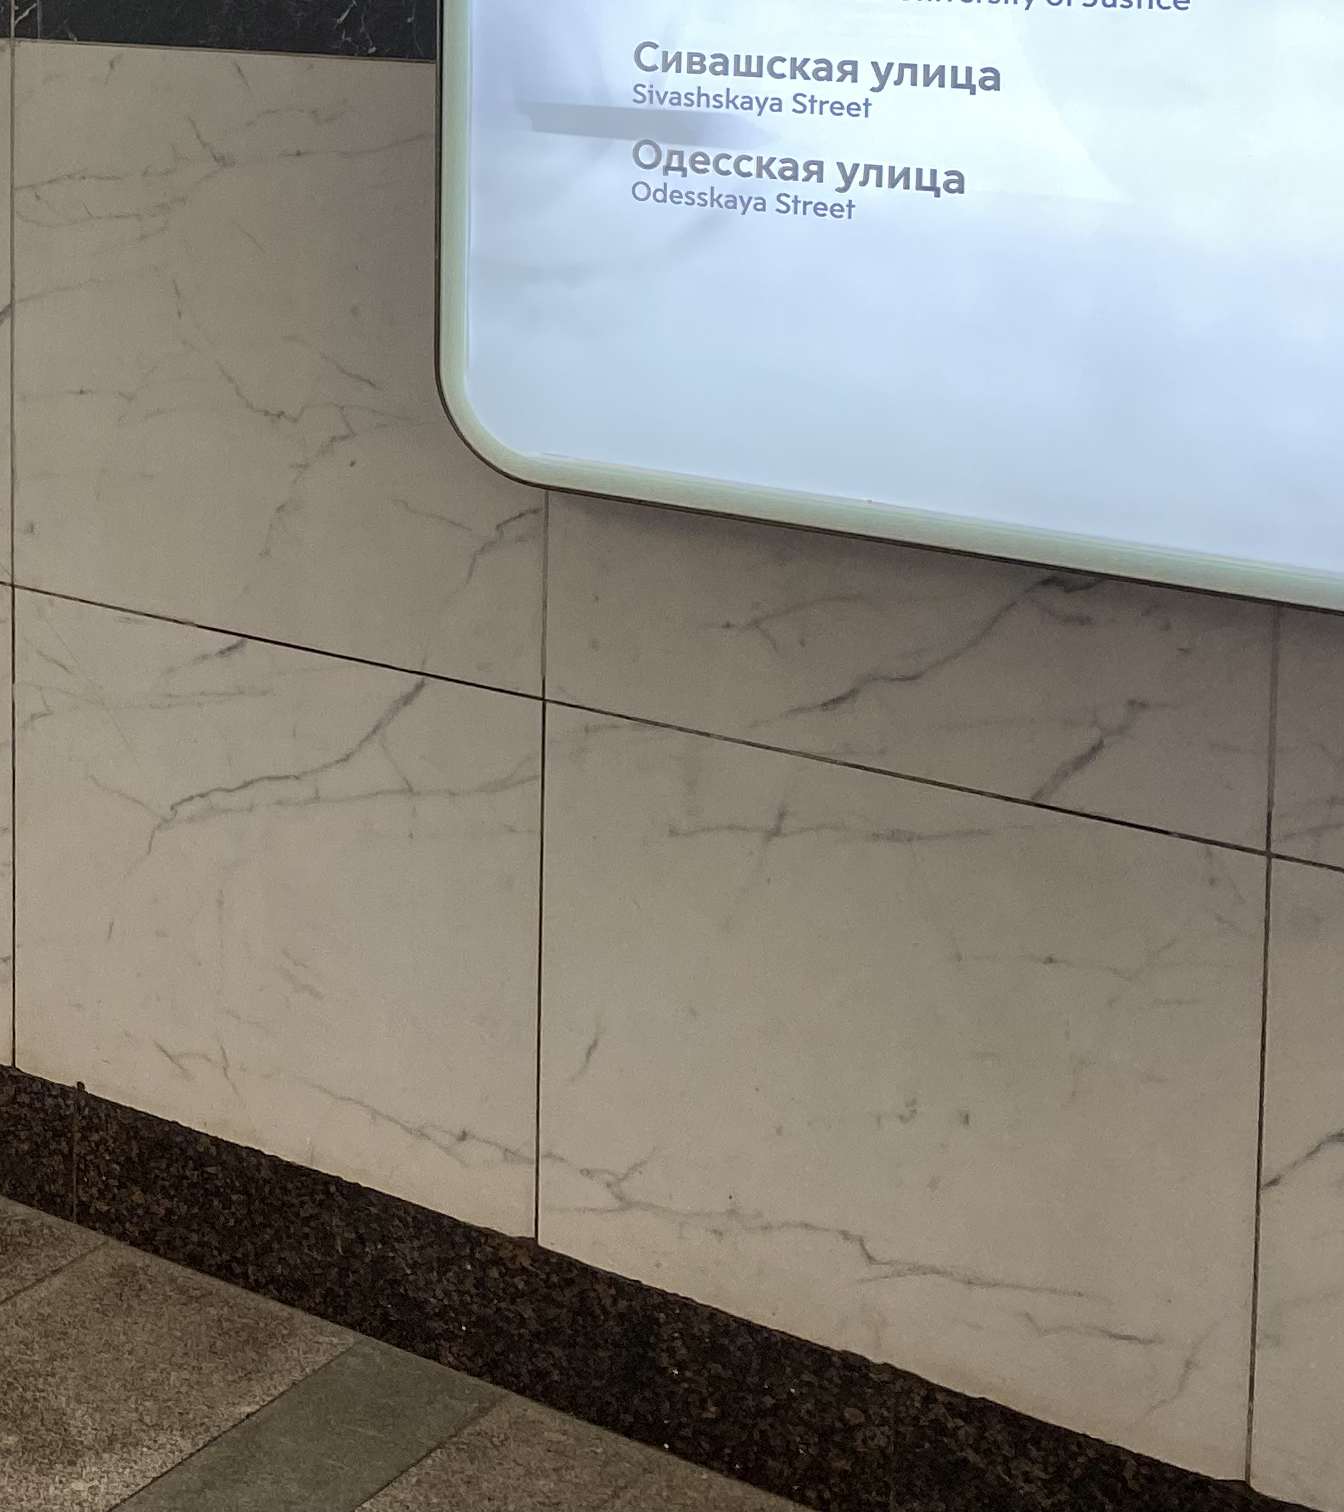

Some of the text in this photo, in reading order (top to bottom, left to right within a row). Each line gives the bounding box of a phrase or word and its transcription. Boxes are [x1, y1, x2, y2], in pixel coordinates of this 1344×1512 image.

[632, 41, 1002, 95] Сивашская улица
[632, 83, 872, 118] Sivashskaya Street
[632, 139, 966, 196] Одесская улица
[631, 180, 856, 219] Odesskaya Street
